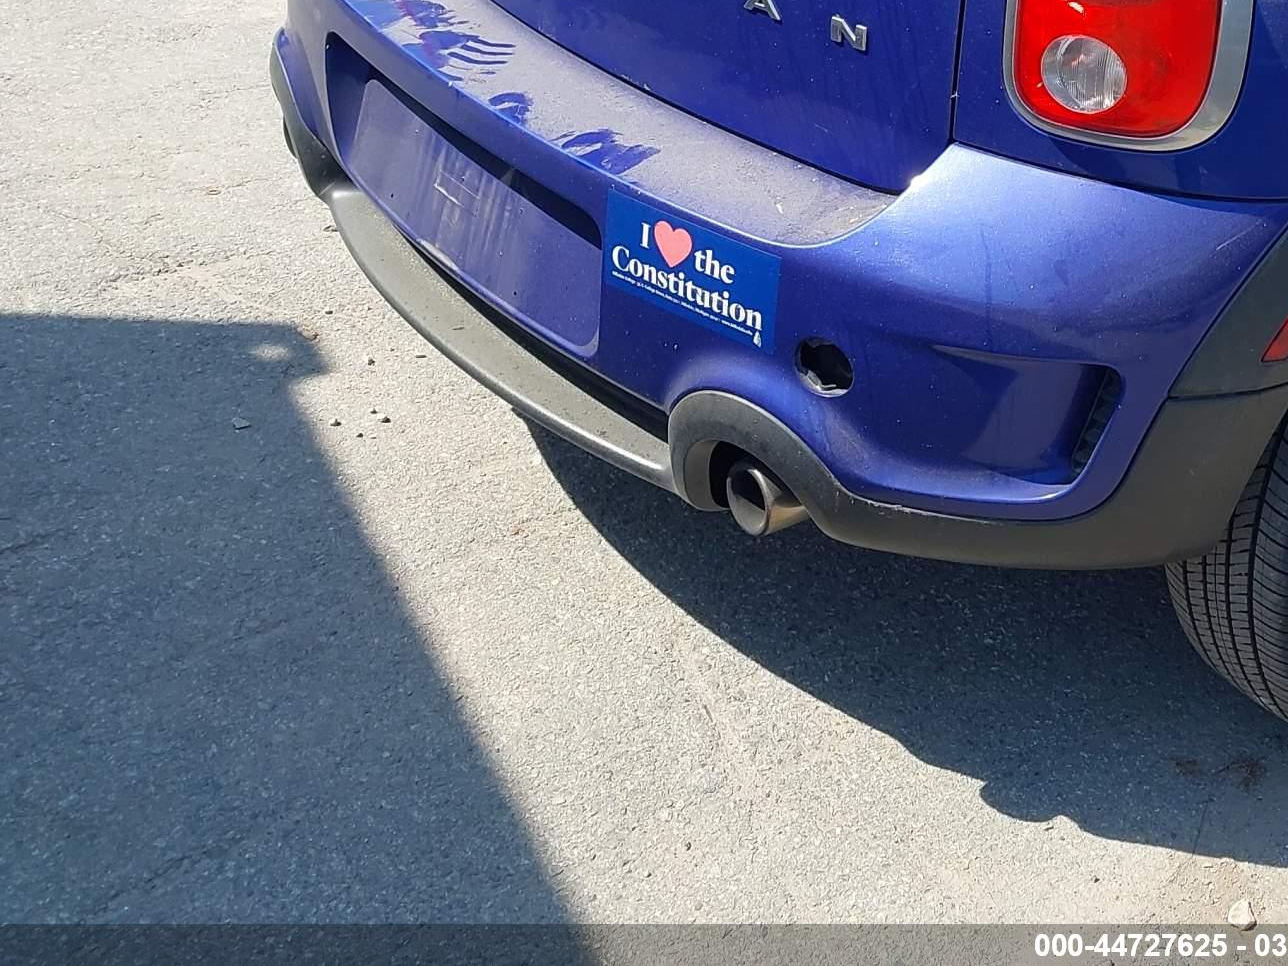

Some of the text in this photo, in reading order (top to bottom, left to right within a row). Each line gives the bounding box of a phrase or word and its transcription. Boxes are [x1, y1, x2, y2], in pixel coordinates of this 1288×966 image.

[612, 245, 762, 330] Constitution
[640, 222, 735, 284] I the
